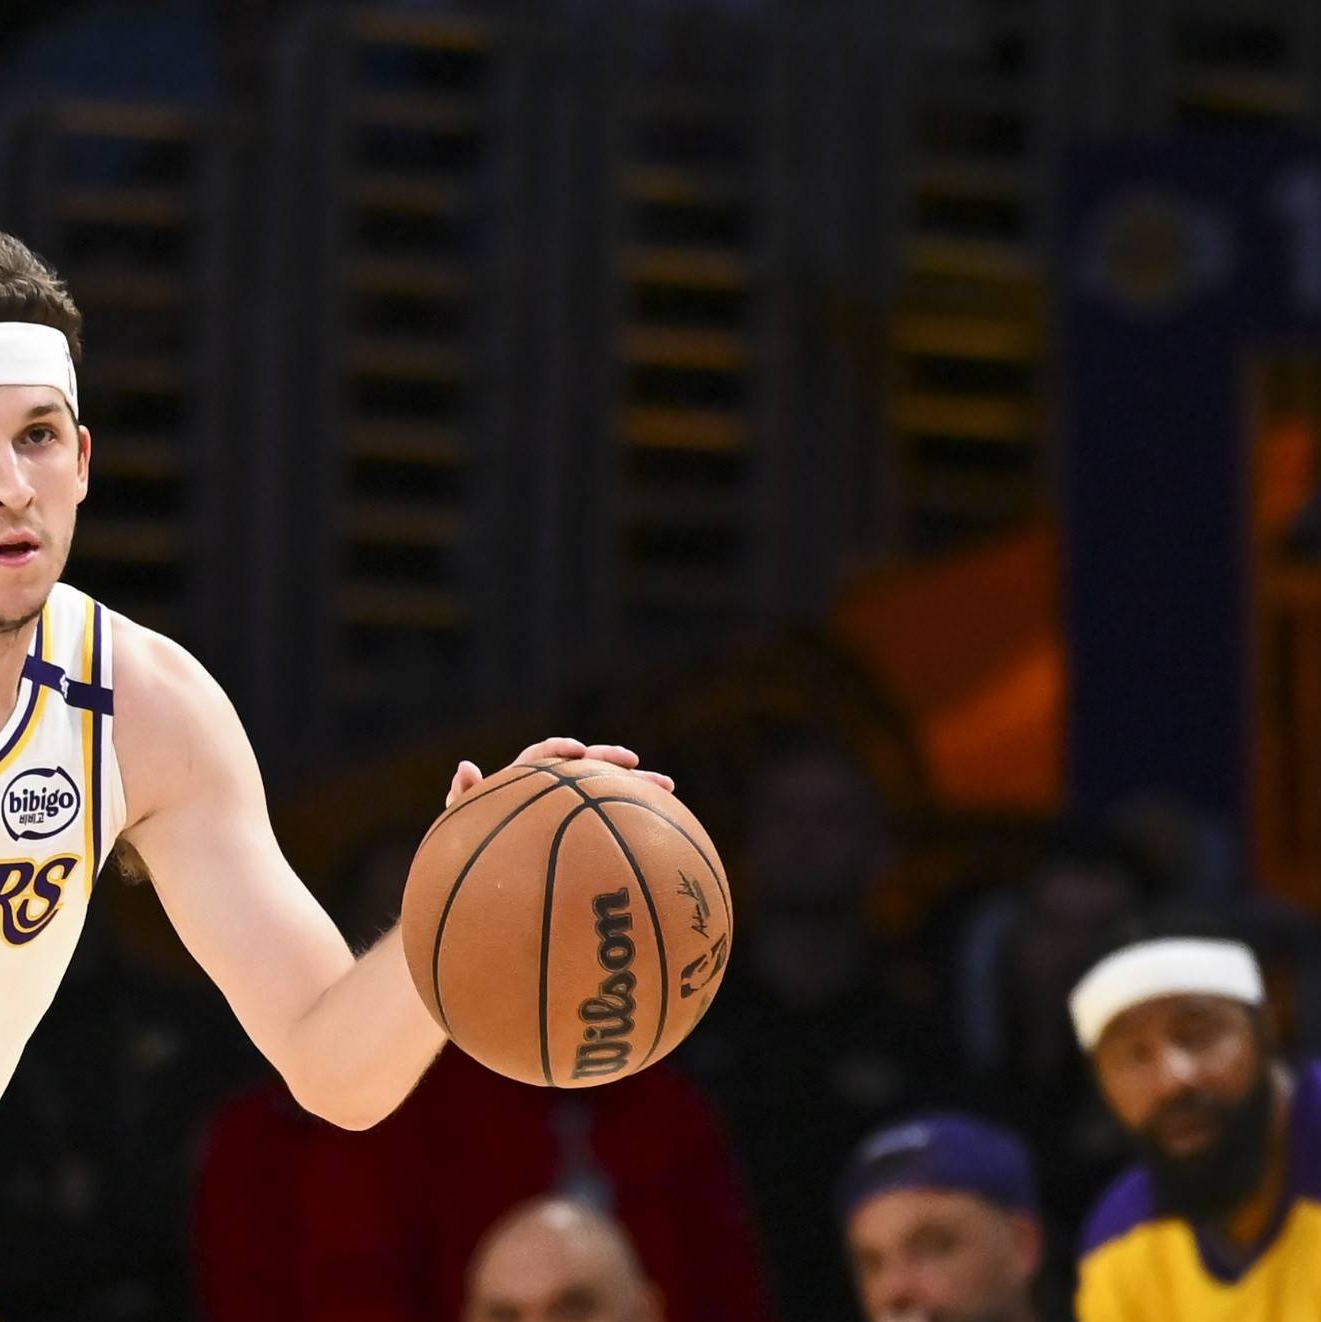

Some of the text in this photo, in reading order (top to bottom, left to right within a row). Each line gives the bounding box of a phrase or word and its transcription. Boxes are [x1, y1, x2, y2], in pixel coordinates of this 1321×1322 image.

[9, 787, 74, 817] bibigo
[19, 812, 44, 825] 비비고
[571, 887, 637, 1080] Wilson
